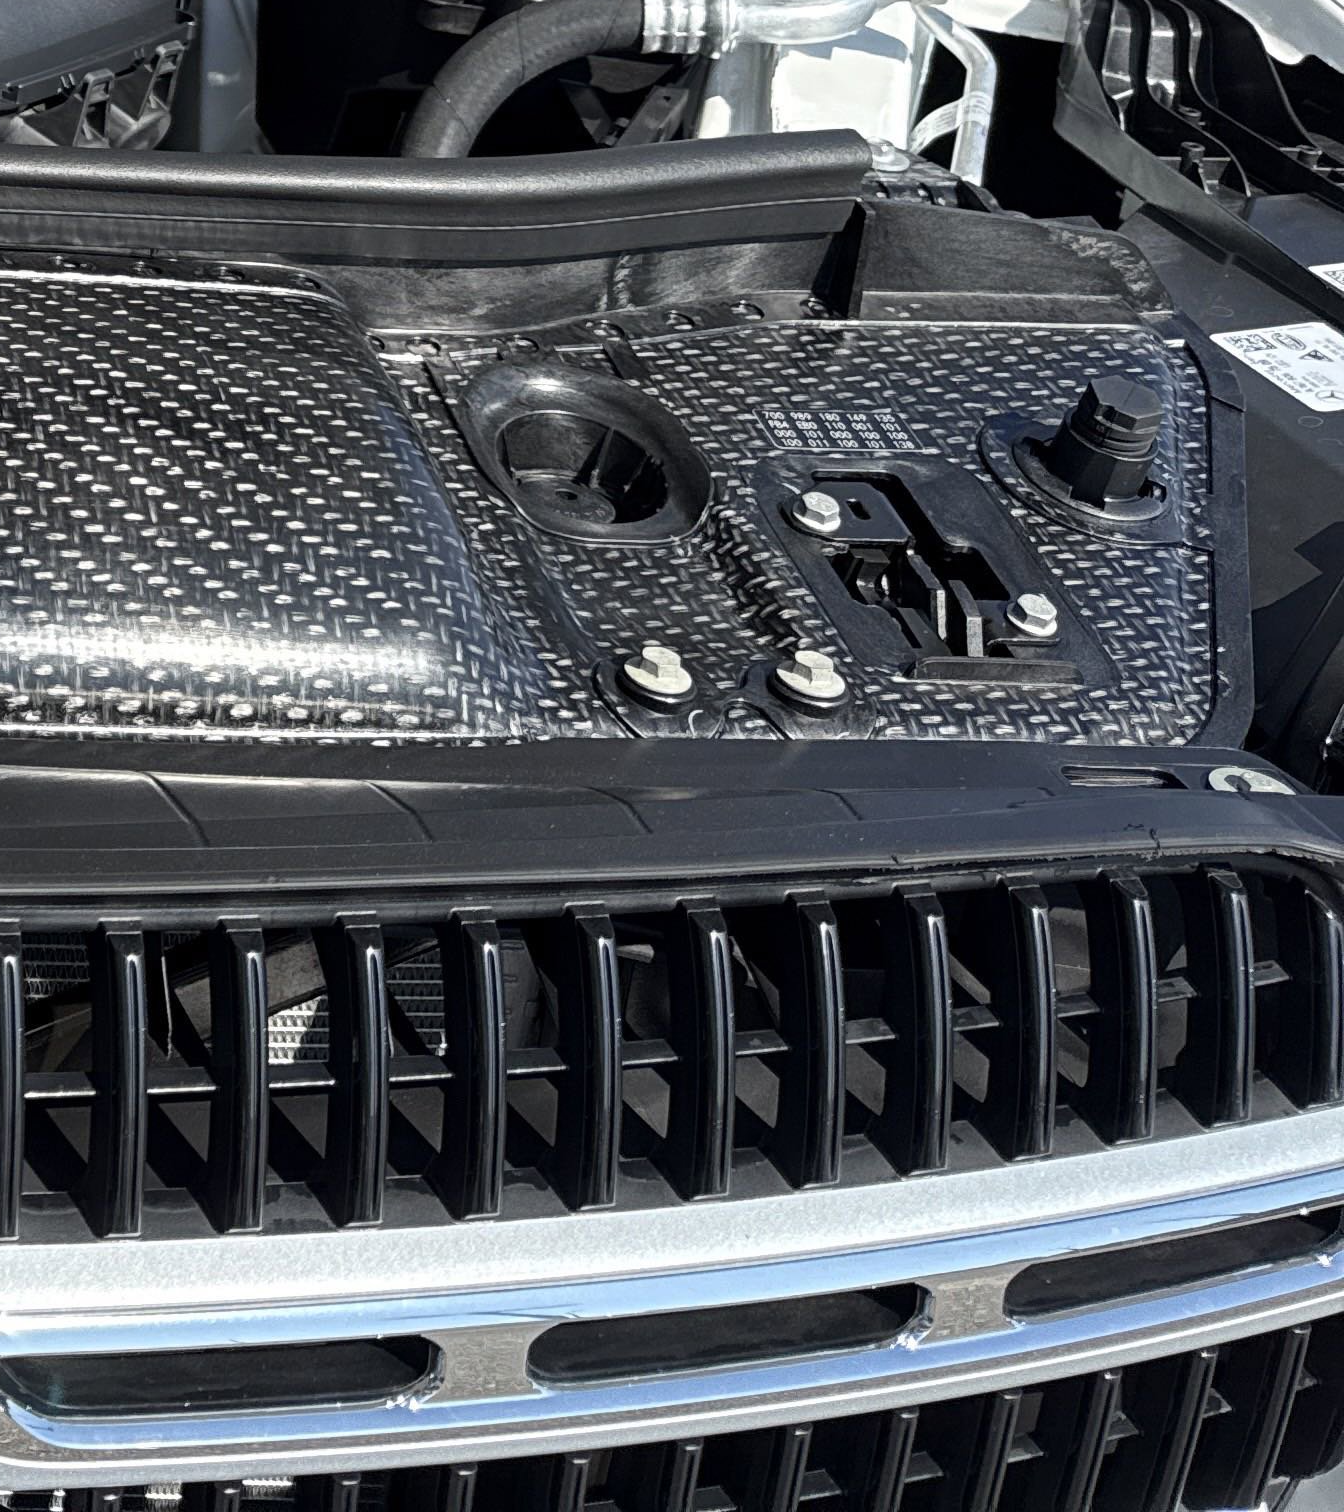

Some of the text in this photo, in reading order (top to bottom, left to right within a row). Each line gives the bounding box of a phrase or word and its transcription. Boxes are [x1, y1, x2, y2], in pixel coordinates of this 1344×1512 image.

[762, 411, 784, 420] 700
[846, 413, 866, 421] 149
[874, 414, 895, 422] 135
[824, 422, 846, 430] 110
[851, 422, 873, 430] 001
[880, 423, 901, 431] 101
[774, 429, 908, 440] 000 101 000 100 100
[781, 438, 802, 447] 100
[808, 439, 829, 447] 011
[837, 440, 858, 448] 100
